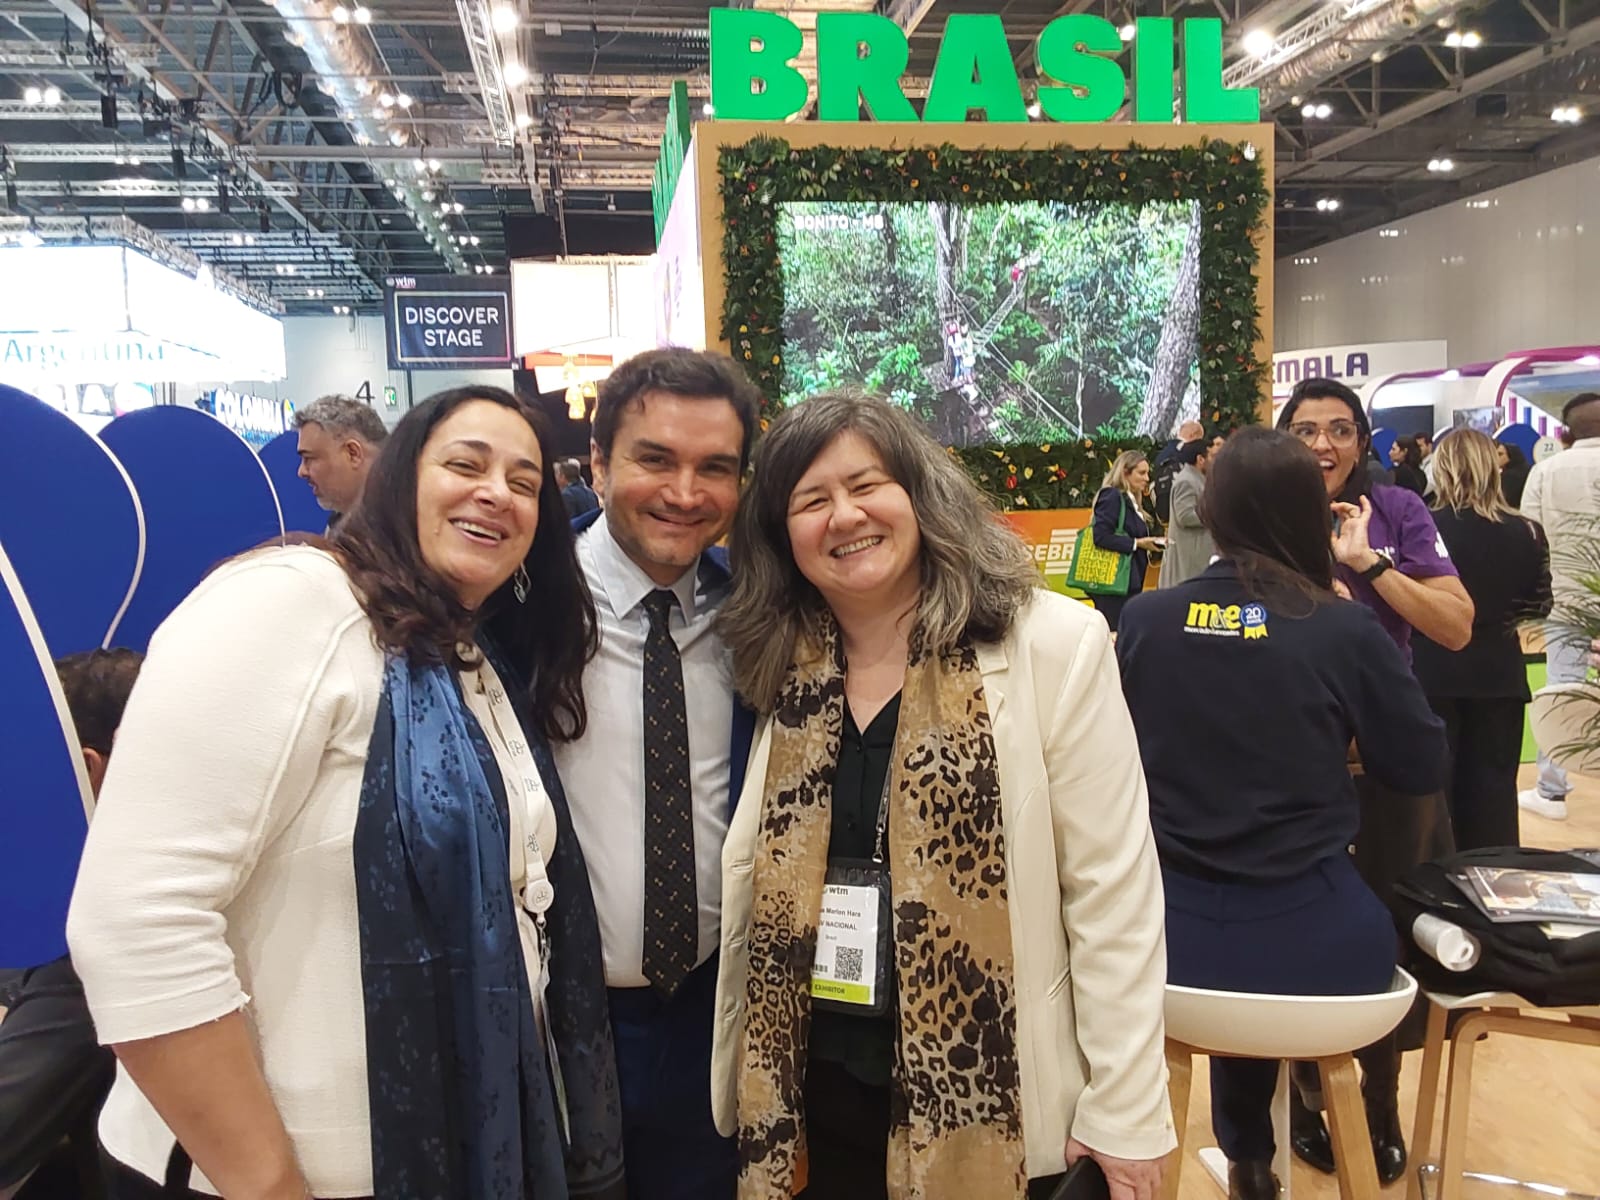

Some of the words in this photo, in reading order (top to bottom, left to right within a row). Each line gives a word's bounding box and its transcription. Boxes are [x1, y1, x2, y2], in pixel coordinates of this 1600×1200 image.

[709, 8, 1260, 122] BRASIL
[794, 214, 848, 230] BONITO
[395, 276, 416, 288] wtm
[405, 307, 499, 325] DISCOVER
[424, 329, 484, 347] STAGE
[5, 338, 164, 369] Argentina
[1272, 352, 1369, 384] MALA
[355, 380, 376, 405] 4
[1245, 606, 1262, 619] 20
[829, 887, 849, 896] wtm
[825, 920, 857, 930] NACIONAL
[814, 983, 846, 994] EXHIBITOR
